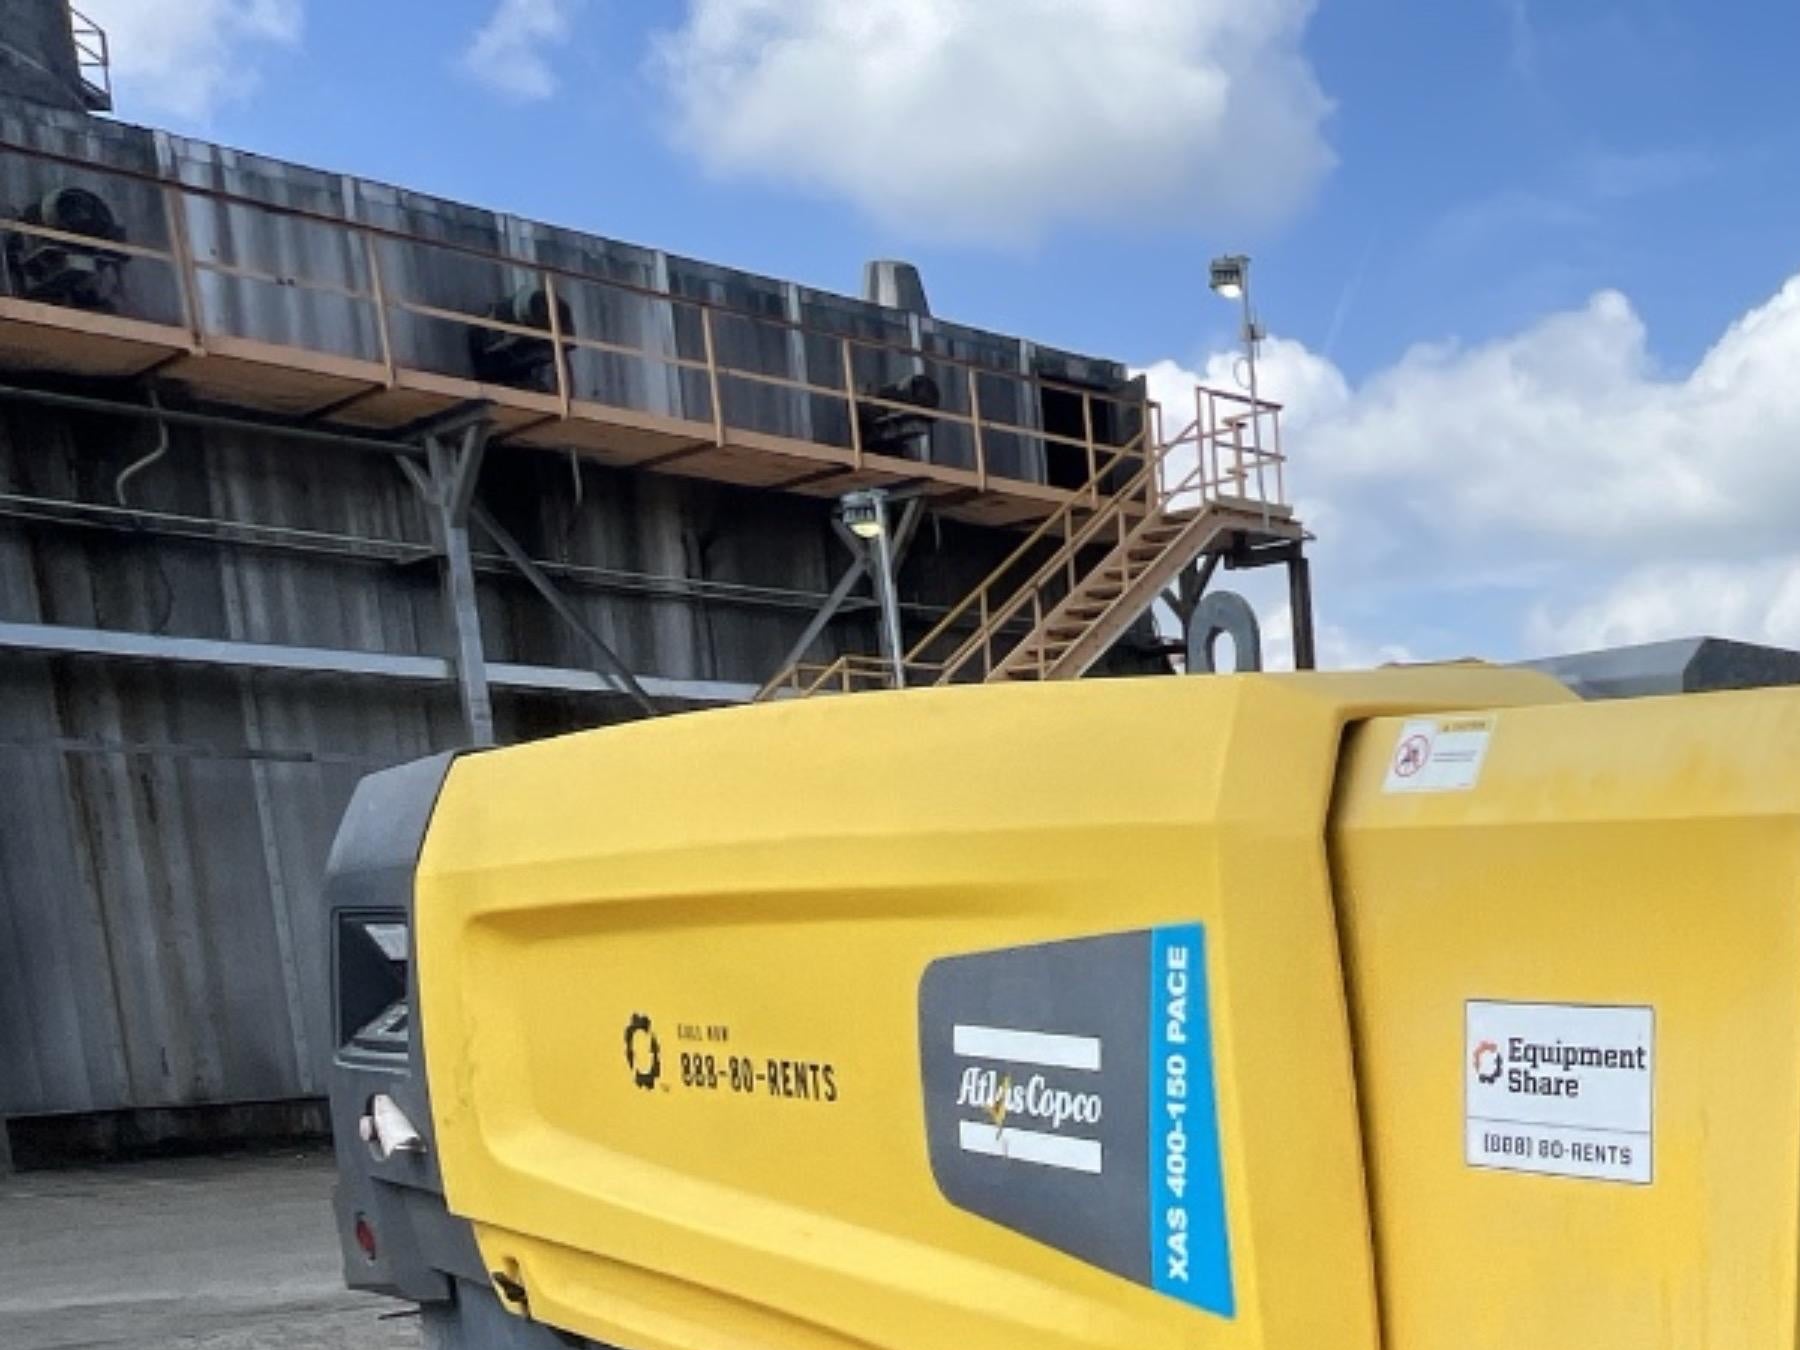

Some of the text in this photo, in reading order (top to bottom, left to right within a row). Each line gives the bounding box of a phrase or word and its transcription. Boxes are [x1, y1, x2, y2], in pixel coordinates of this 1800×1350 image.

[1507, 1036, 1647, 1072] Equipment
[680, 1051, 838, 1102] 888-80-RENTS
[1507, 1068, 1580, 1098] Share
[1166, 946, 1189, 1283] XAS 400-150 PACE
